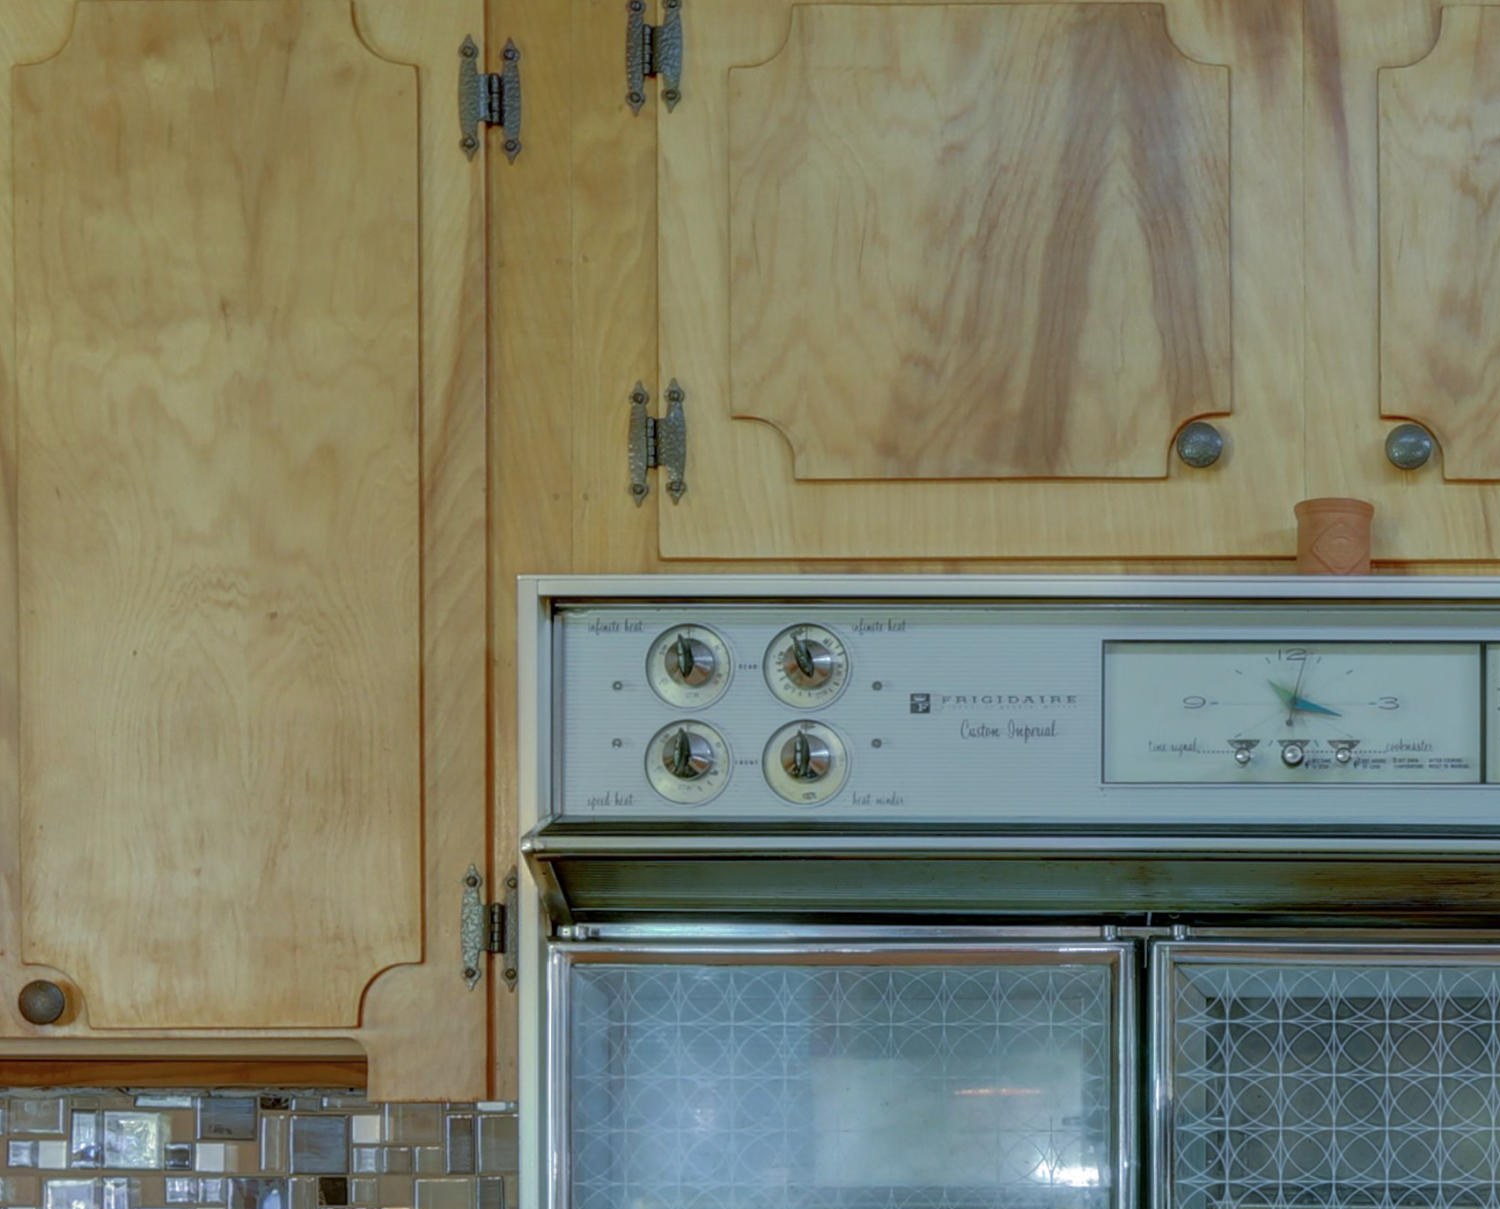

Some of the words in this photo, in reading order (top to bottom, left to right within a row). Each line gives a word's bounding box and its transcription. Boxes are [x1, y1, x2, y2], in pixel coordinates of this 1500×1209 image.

[1277, 648, 1306, 661] 12
[941, 695, 1078, 705] FRIGIDAIRE
[1183, 696, 1207, 709] 9
[1378, 696, 1400, 710] 3
[960, 719, 1001, 740] Custom
[1007, 719, 1058, 744] Imperial
